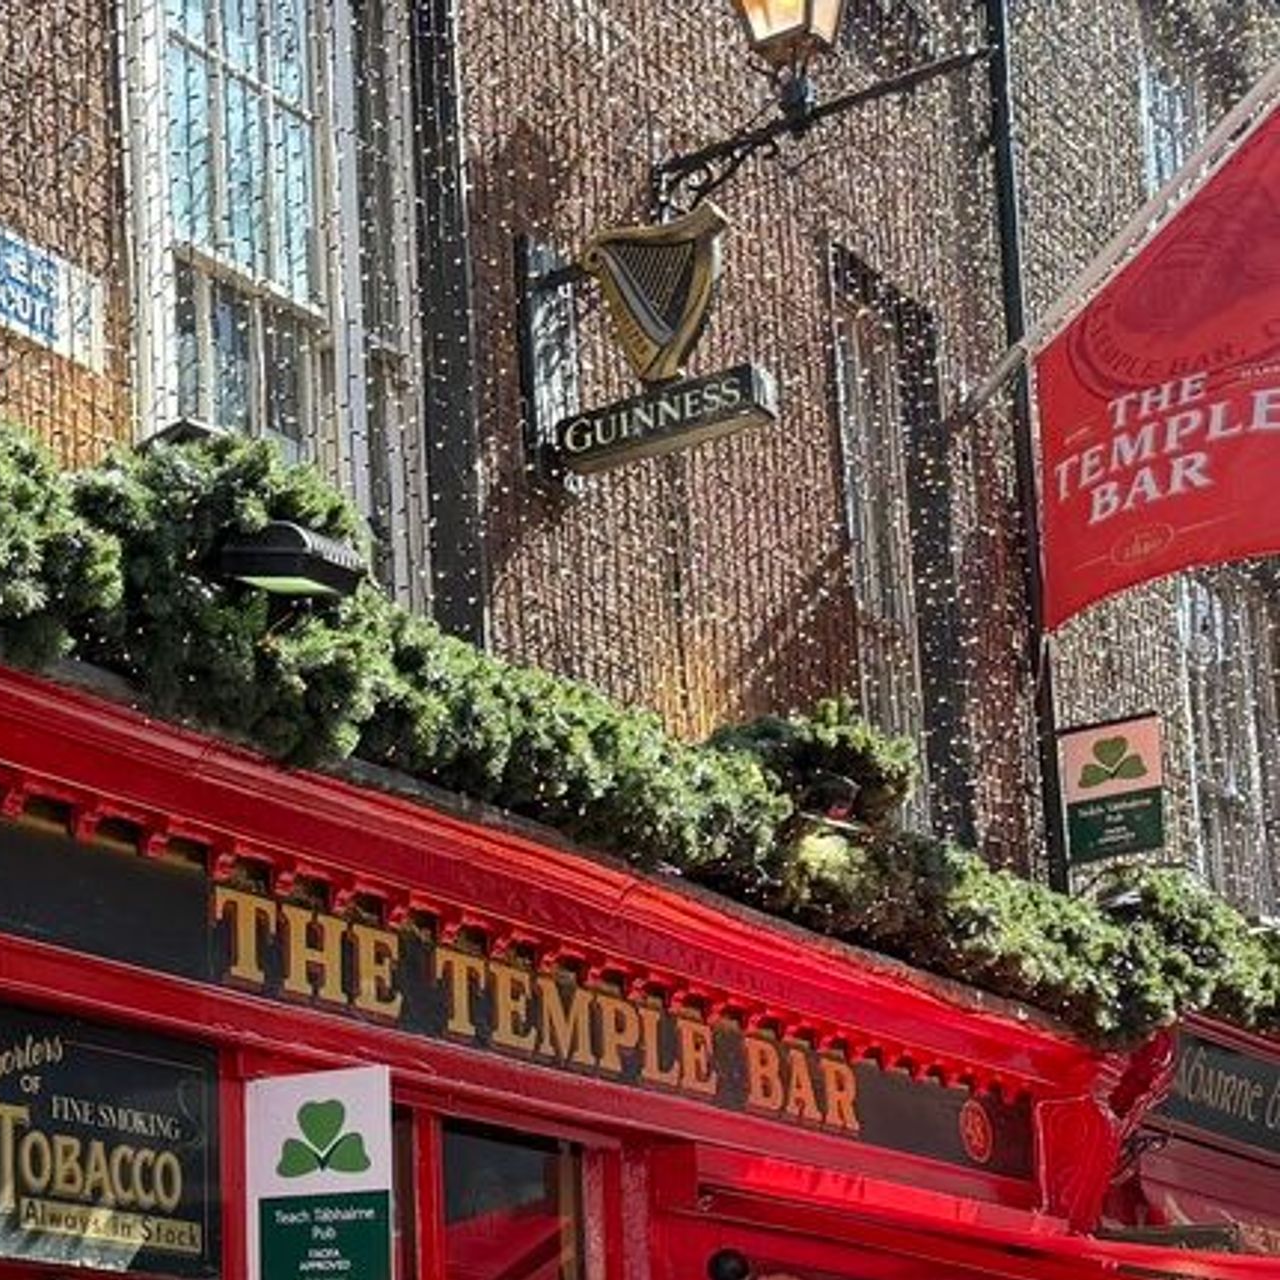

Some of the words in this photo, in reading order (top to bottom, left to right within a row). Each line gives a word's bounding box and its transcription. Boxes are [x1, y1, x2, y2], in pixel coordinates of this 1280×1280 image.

[565, 377, 741, 452] GUINNESS
[1109, 371, 1208, 430] THE
[1054, 387, 1280, 503] TEMPLE
[1088, 451, 1215, 524] BAR
[215, 885, 403, 1019] THE
[436, 947, 718, 1096] TEMPLE
[746, 1037, 859, 1132] BAR
[20, 1075, 41, 1093] OF
[52, 1096, 95, 1125] FINE
[98, 1103, 182, 1140] SMOKING
[25, 1202, 101, 1232] Always
[141, 1219, 198, 1247] Stock
[275, 1209, 310, 1226] Teach
[311, 1225, 336, 1241] Pub
